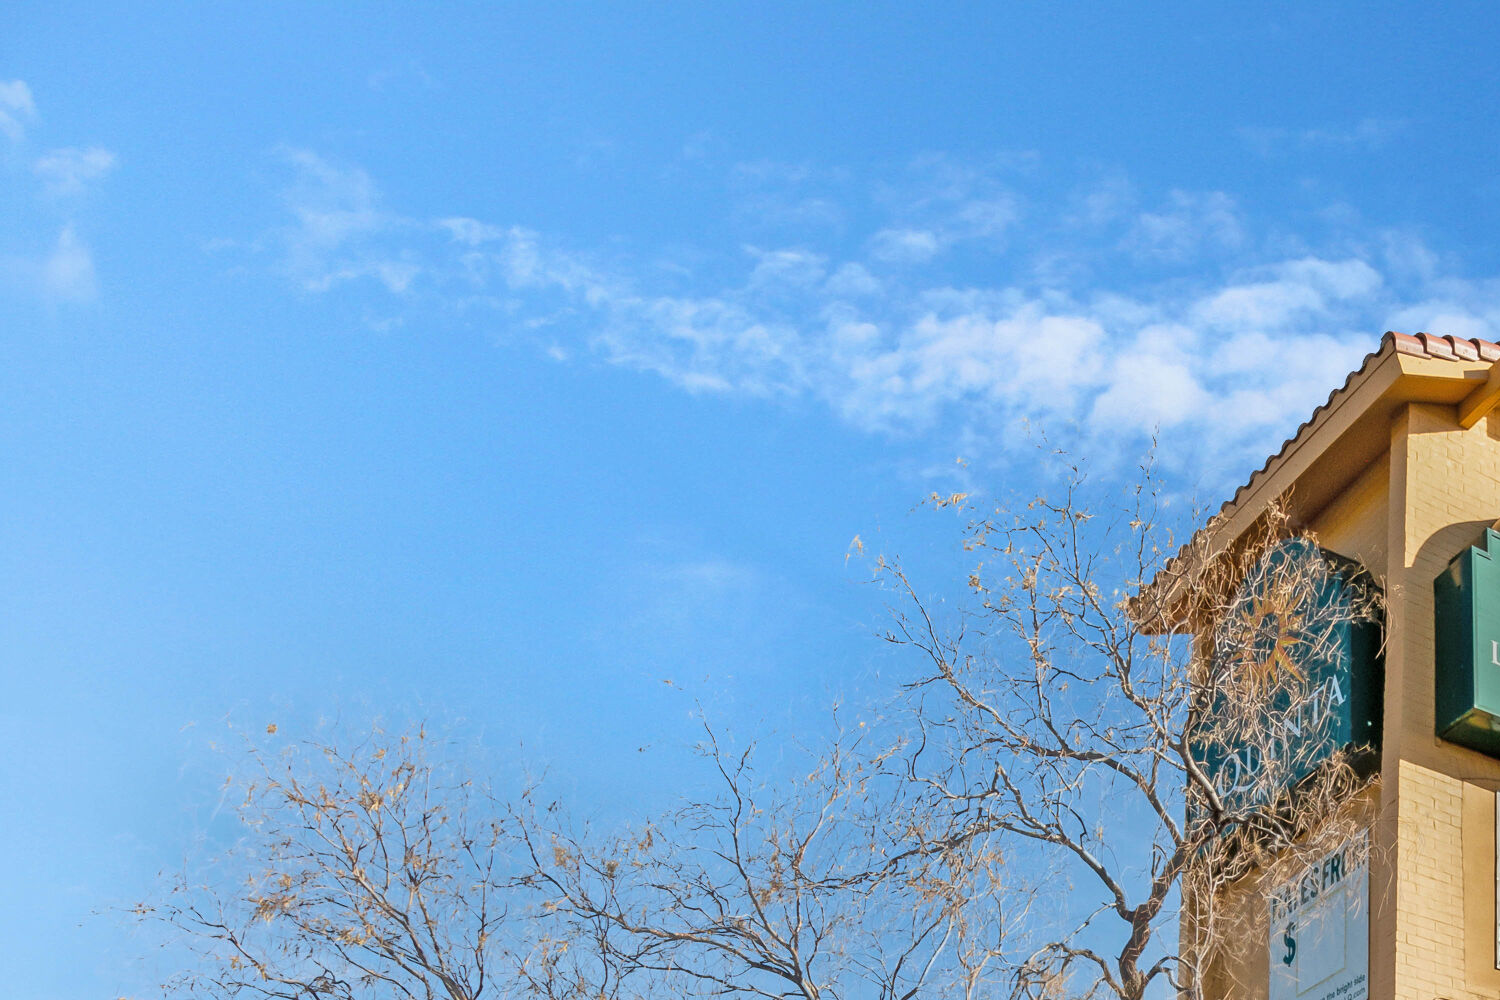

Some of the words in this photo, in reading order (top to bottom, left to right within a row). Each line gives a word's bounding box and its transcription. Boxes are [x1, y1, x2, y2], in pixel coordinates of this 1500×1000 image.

[1283, 922, 1296, 967] $
[1337, 981, 1352, 995] bright
[1354, 974, 1366, 986] side
